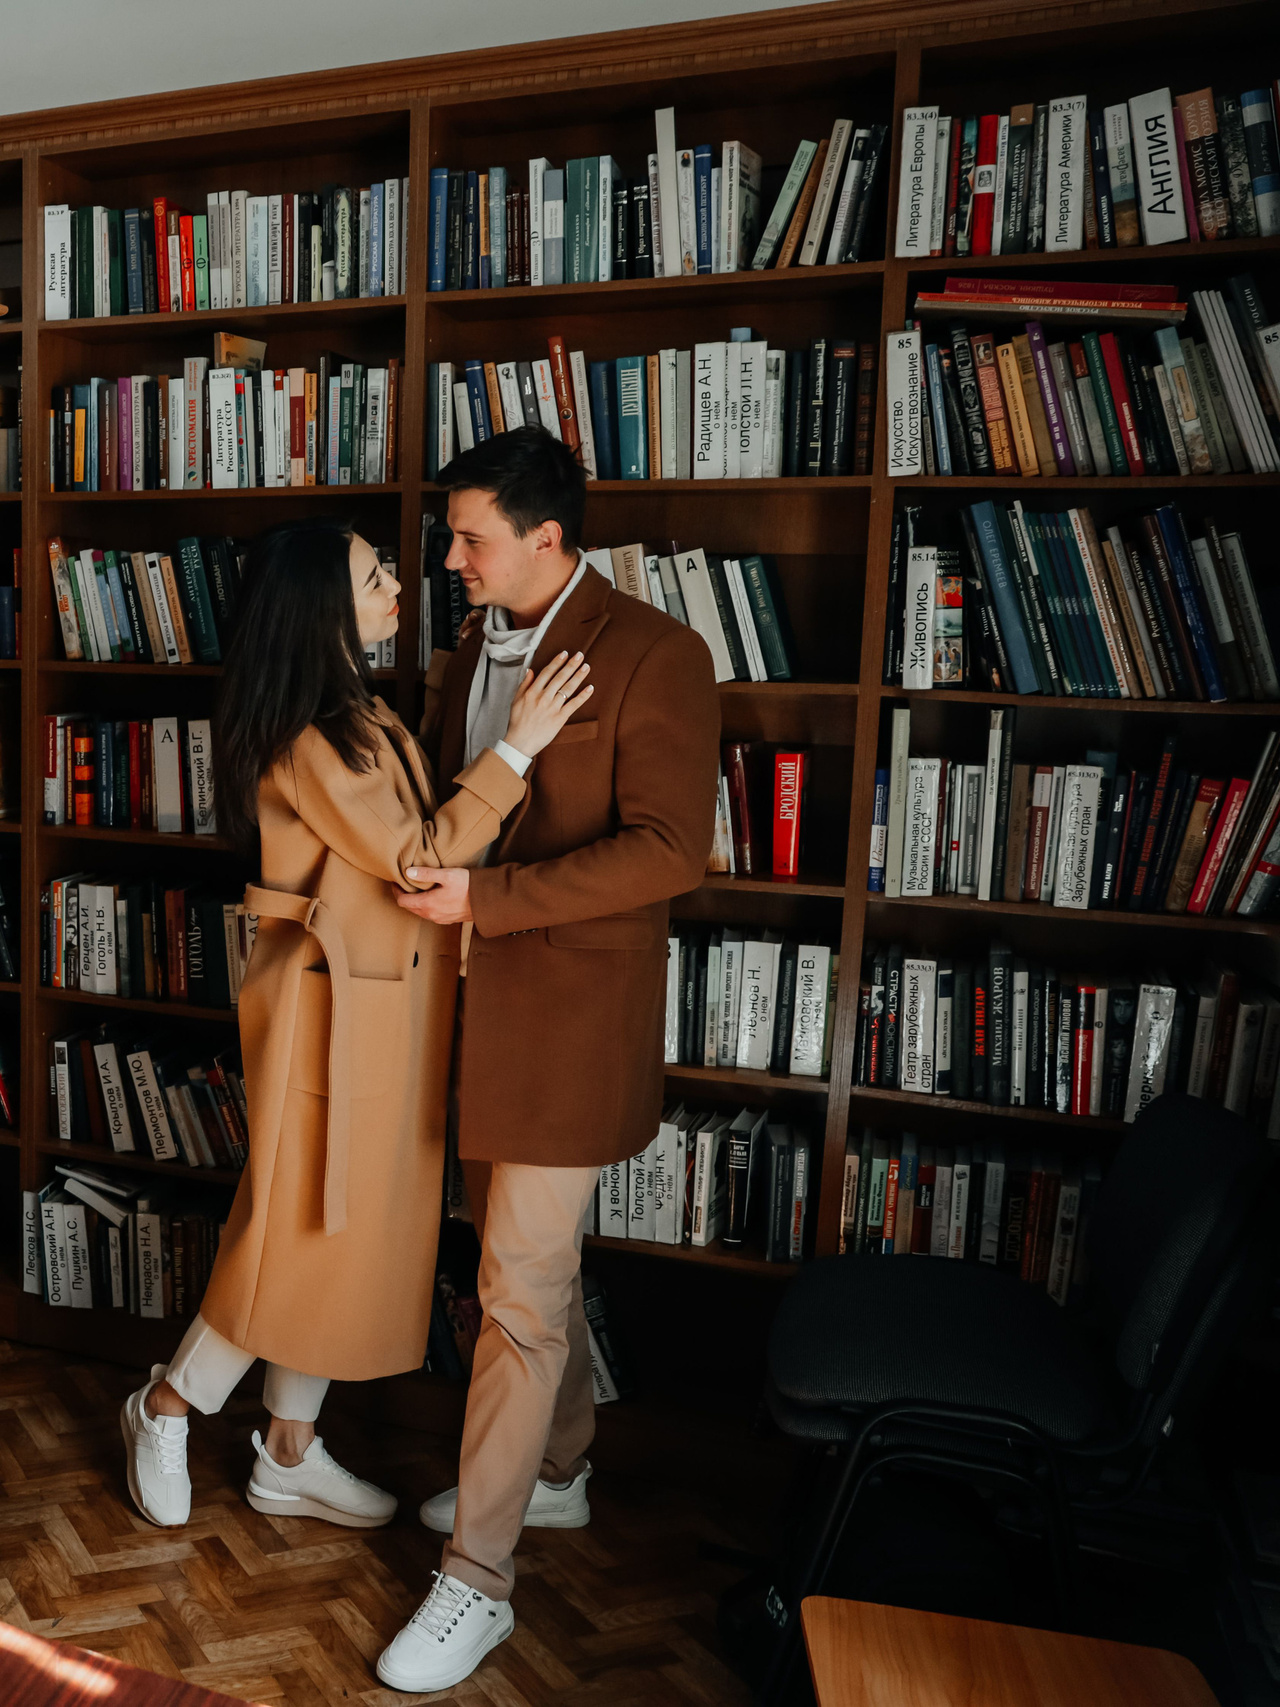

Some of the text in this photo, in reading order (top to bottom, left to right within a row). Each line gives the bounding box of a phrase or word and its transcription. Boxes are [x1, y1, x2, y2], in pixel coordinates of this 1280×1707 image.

[906, 112, 938, 121] 83.3(4)
[1052, 101, 1085, 113] 83.3(7)
[905, 124, 926, 248] Литература Европы
[1055, 114, 1074, 243] Литература Америки
[1185, 102, 1214, 232] СЕСИЛ МОРИС БОУРА
[1198, 99, 1228, 228] ГЕРОИЧЕСКАЯ ПОЭЗИЯ
[48, 253, 58, 292] Русская
[58, 242, 68, 299] литература
[898, 338, 912, 349] 85
[1264, 332, 1280, 344] 85
[620, 368, 640, 417] ПУШКИН
[740, 356, 754, 390] Л.Н.
[188, 399, 197, 468] ХРЕСТОМАТИЯ
[224, 400, 233, 427] СССР
[697, 354, 713, 462] Радищев А.Н.
[713, 400, 721, 420] нем
[730, 401, 738, 421] нем
[753, 400, 761, 419] нем
[890, 397, 907, 468] Искусство.
[906, 352, 923, 467] Искусствознание
[215, 408, 224, 467] Литература
[225, 437, 234, 473] России
[180, 547, 196, 602] ЛИТЕРАТУРА
[190, 544, 201, 569] РУСИ
[686, 557, 697, 573] А
[911, 552, 937, 562] 85.14
[161, 728, 174, 743] А
[192, 730, 208, 827] Белинский В.Г.
[779, 761, 796, 820] БРОДСКИЙ
[906, 775, 924, 891] Музыкальная культура
[1029, 811, 1043, 891] ИСТОРИЯ РУССКОЙ МУЗЫКИ
[1071, 806, 1092, 903] Зарубежных стран
[917, 853, 930, 891] России
[80, 905, 91, 978] Герцен А.И.
[96, 935, 107, 976] Гоголь
[186, 925, 204, 979] ГОГОЛЬ
[801, 955, 816, 970] В.
[742, 965, 761, 1038] Леонов Н.
[760, 995, 768, 1014] нем
[974, 987, 986, 1057] ЖАН ВИЛАР
[991, 966, 1004, 1067] Михаил ЖАРОВ
[904, 975, 920, 1086] Театр зарубежных
[98, 1058, 123, 1135] Крылов И.А.
[114, 1085, 123, 1102] нем
[920, 1054, 933, 1089] стран
[57, 1072, 68, 1135] ДОСТОЕВСКИЙ
[131, 1055, 168, 1155] Лермонтов М.Ю.
[153, 1095, 163, 1111] нем
[600, 1170, 609, 1188] нем
[646, 1171, 654, 1188] нем
[656, 1149, 666, 1162] К.
[631, 1150, 646, 1222] Толстой А.
[666, 1174, 674, 1192] нем
[609, 1208, 623, 1221] К.
[25, 1208, 36, 1277] Лесков Н.С.
[43, 1206, 62, 1303] Островский А.Н.
[58, 1246, 66, 1262] нем
[66, 1217, 84, 1291] Пушкин А.С.
[139, 1222, 154, 1307] Некрасов Н.А.
